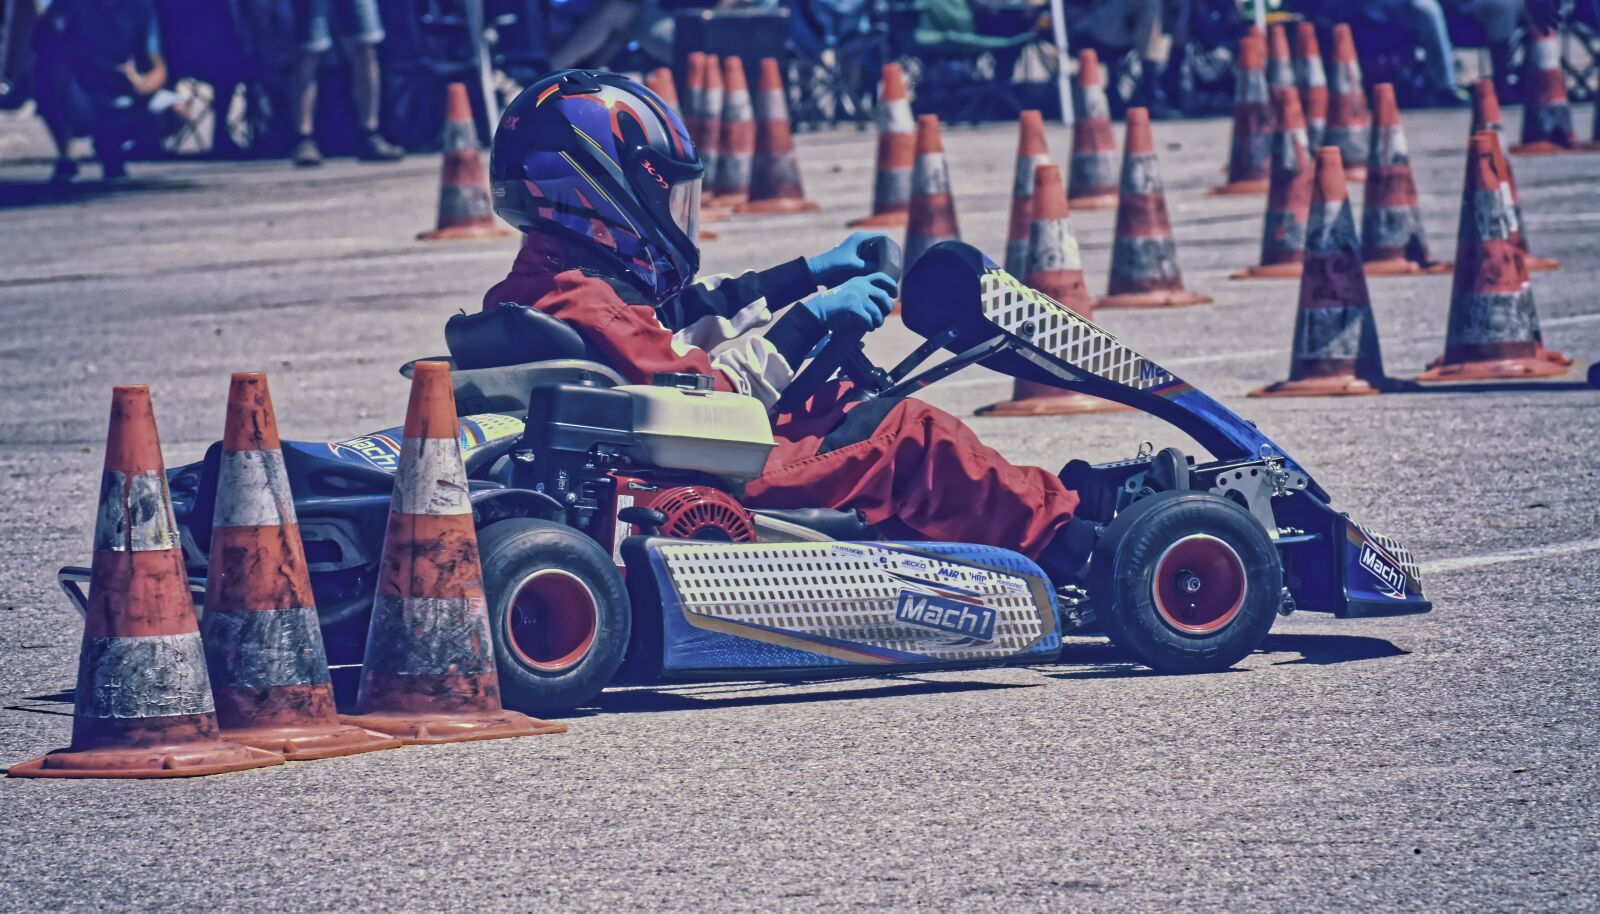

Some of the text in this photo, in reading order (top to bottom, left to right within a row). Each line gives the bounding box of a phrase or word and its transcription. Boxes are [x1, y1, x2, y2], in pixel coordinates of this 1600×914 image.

[901, 559, 927, 570] JECKO
[938, 567, 960, 579] MIR
[1362, 547, 1404, 590] Mach1
[900, 594, 993, 635] Mach1
